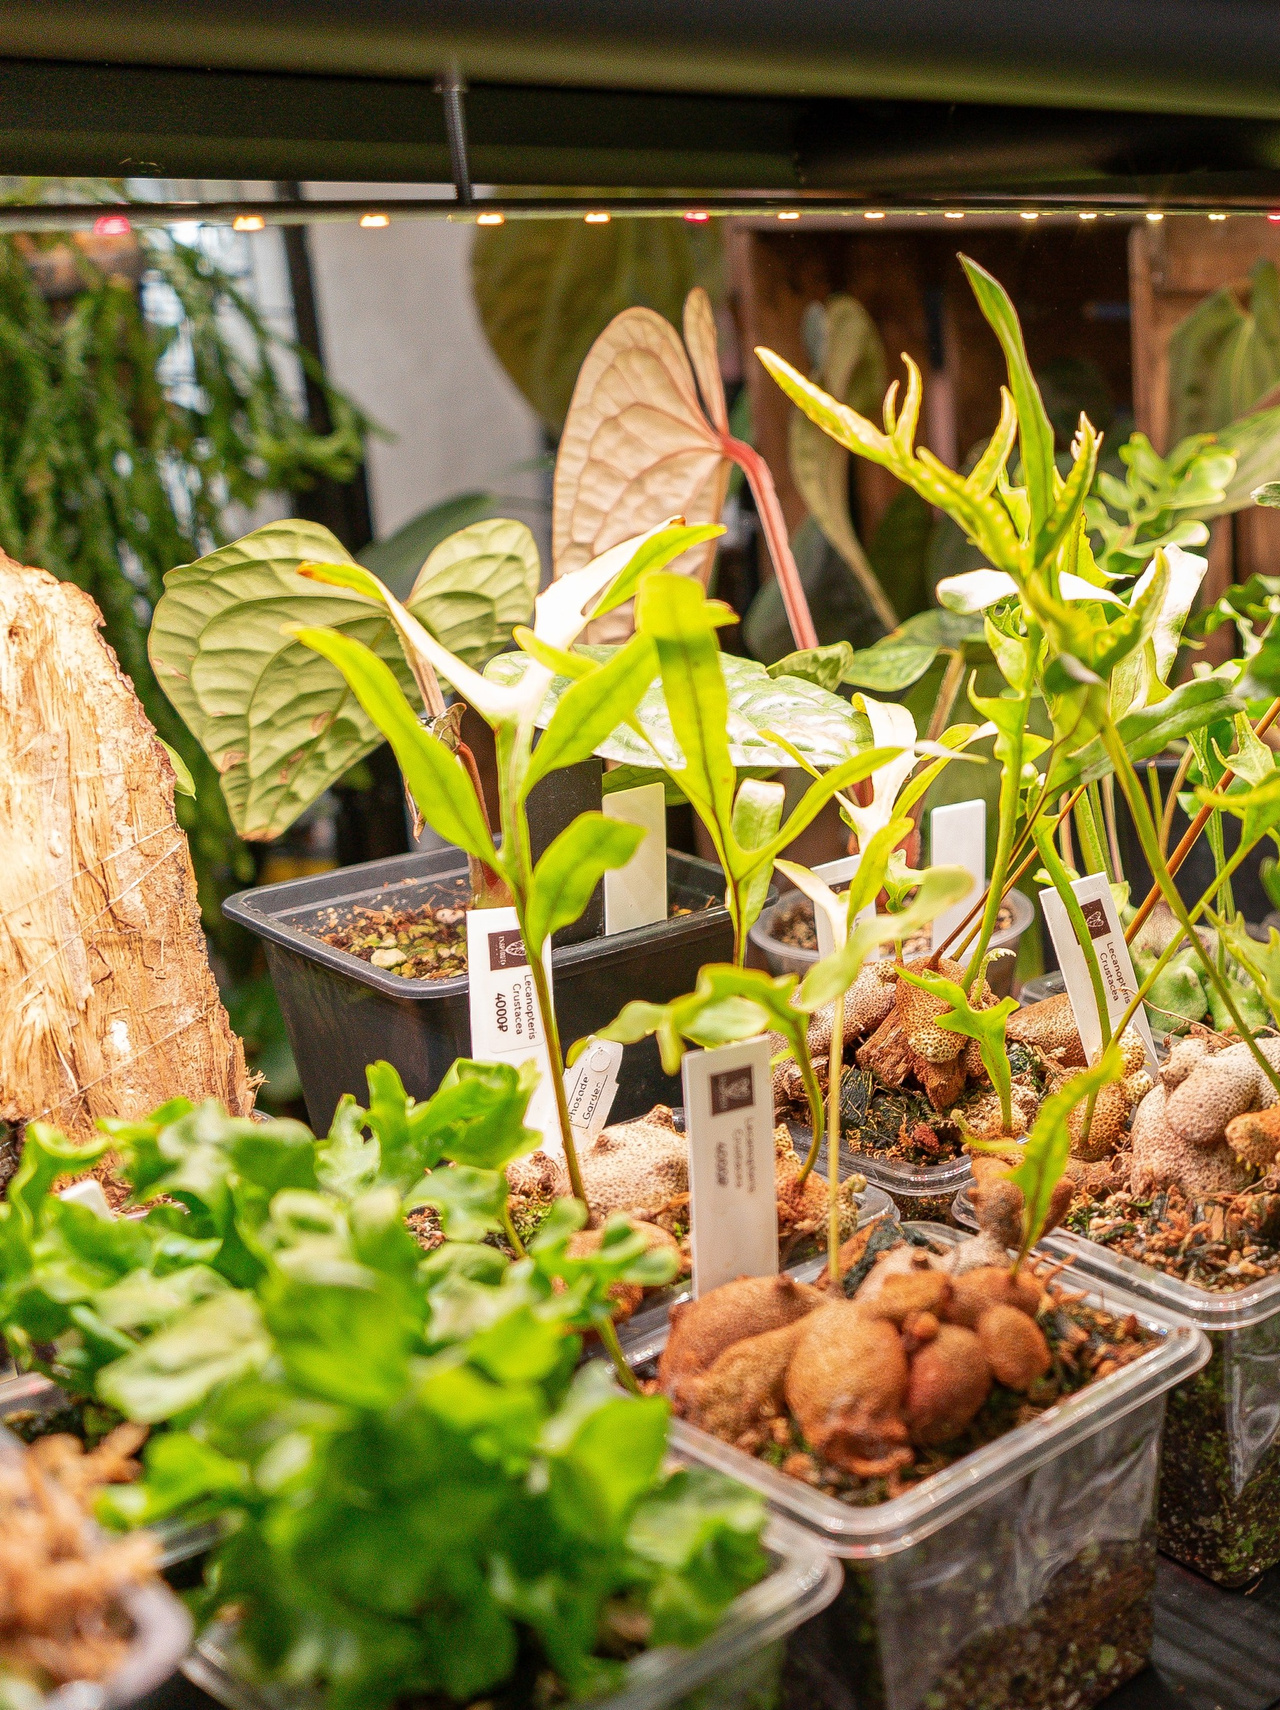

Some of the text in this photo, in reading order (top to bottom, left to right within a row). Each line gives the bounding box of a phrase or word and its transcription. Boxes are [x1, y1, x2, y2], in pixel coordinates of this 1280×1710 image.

[1099, 952, 1119, 1002] Crustacea
[494, 992, 509, 1032] 4000₽
[512, 983, 523, 1035] Crustacea
[524, 973, 536, 1040] Lecanopteris
